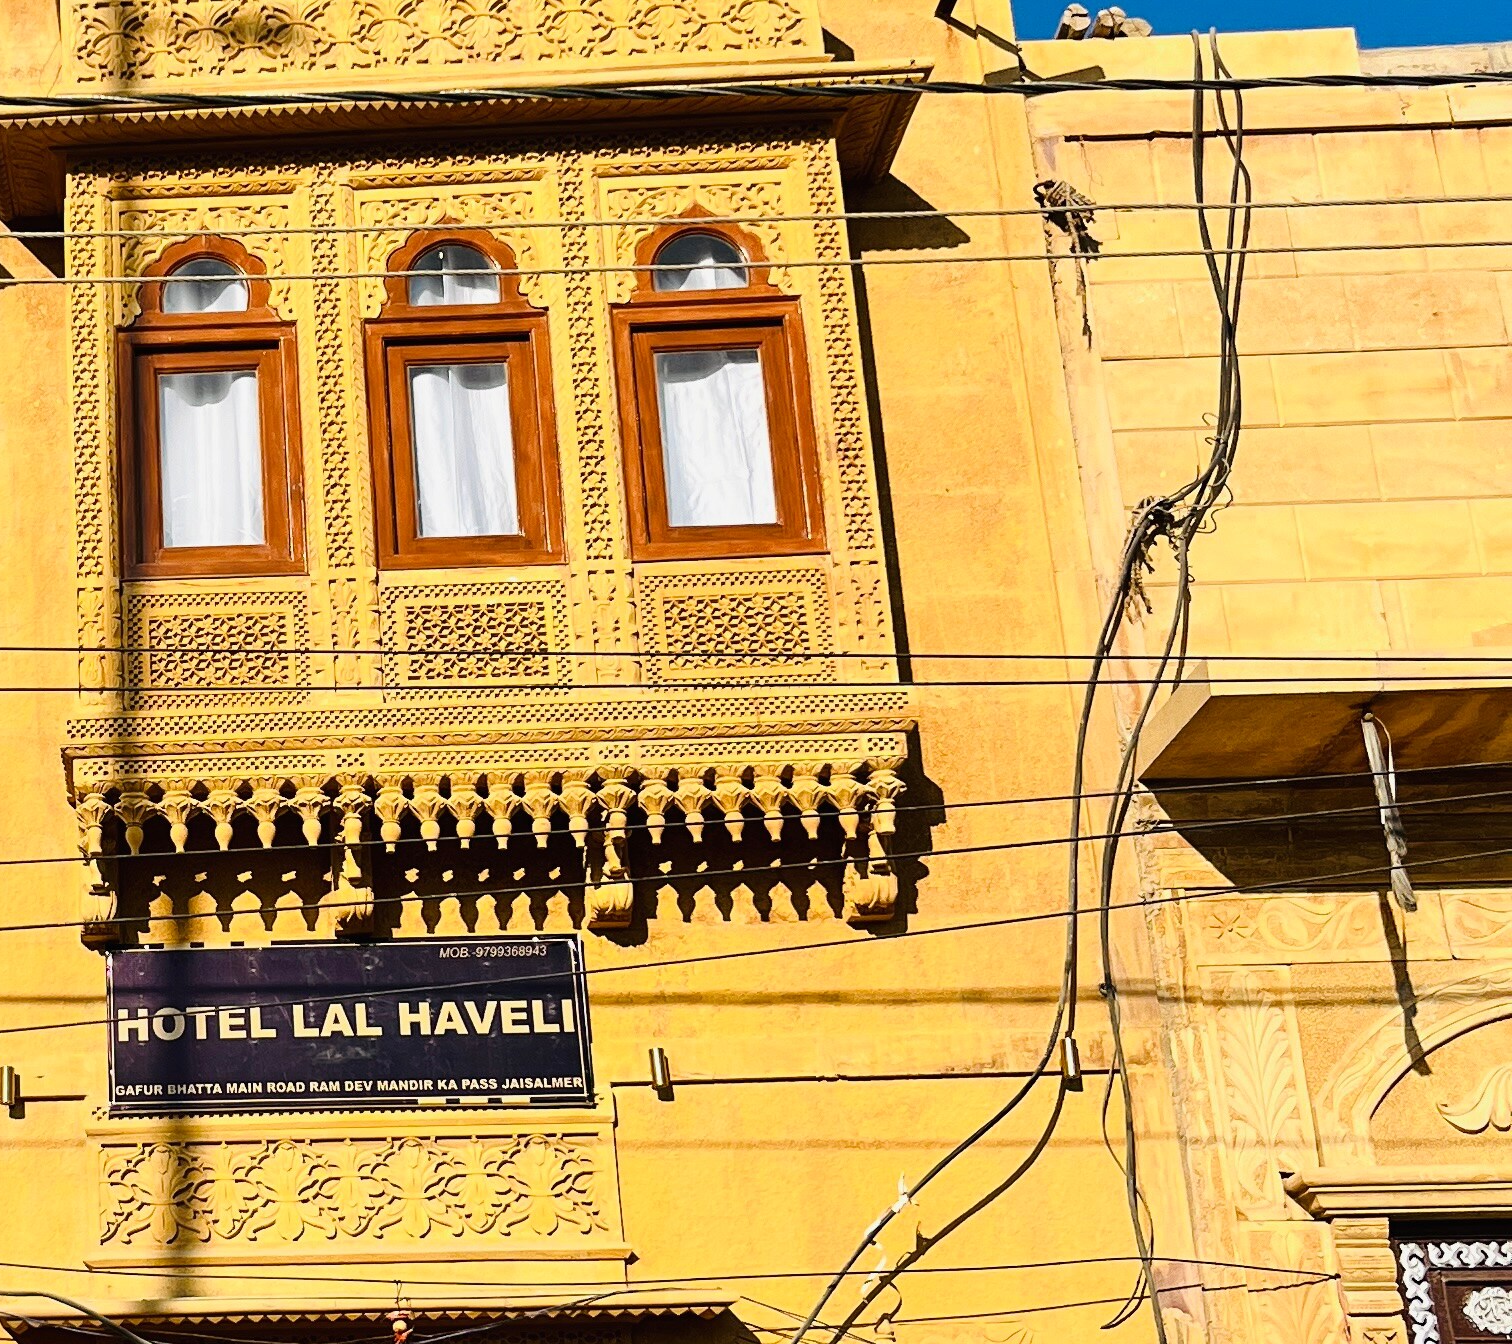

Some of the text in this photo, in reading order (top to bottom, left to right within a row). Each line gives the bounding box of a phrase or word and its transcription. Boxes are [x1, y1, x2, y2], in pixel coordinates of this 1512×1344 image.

[117, 999, 576, 1042] HOTEL LAL HAVELI
[115, 1077, 584, 1096] GAFUR BHATTA MAIN ROAD RAM DEV MANDIR KA PASS JAISALMER
